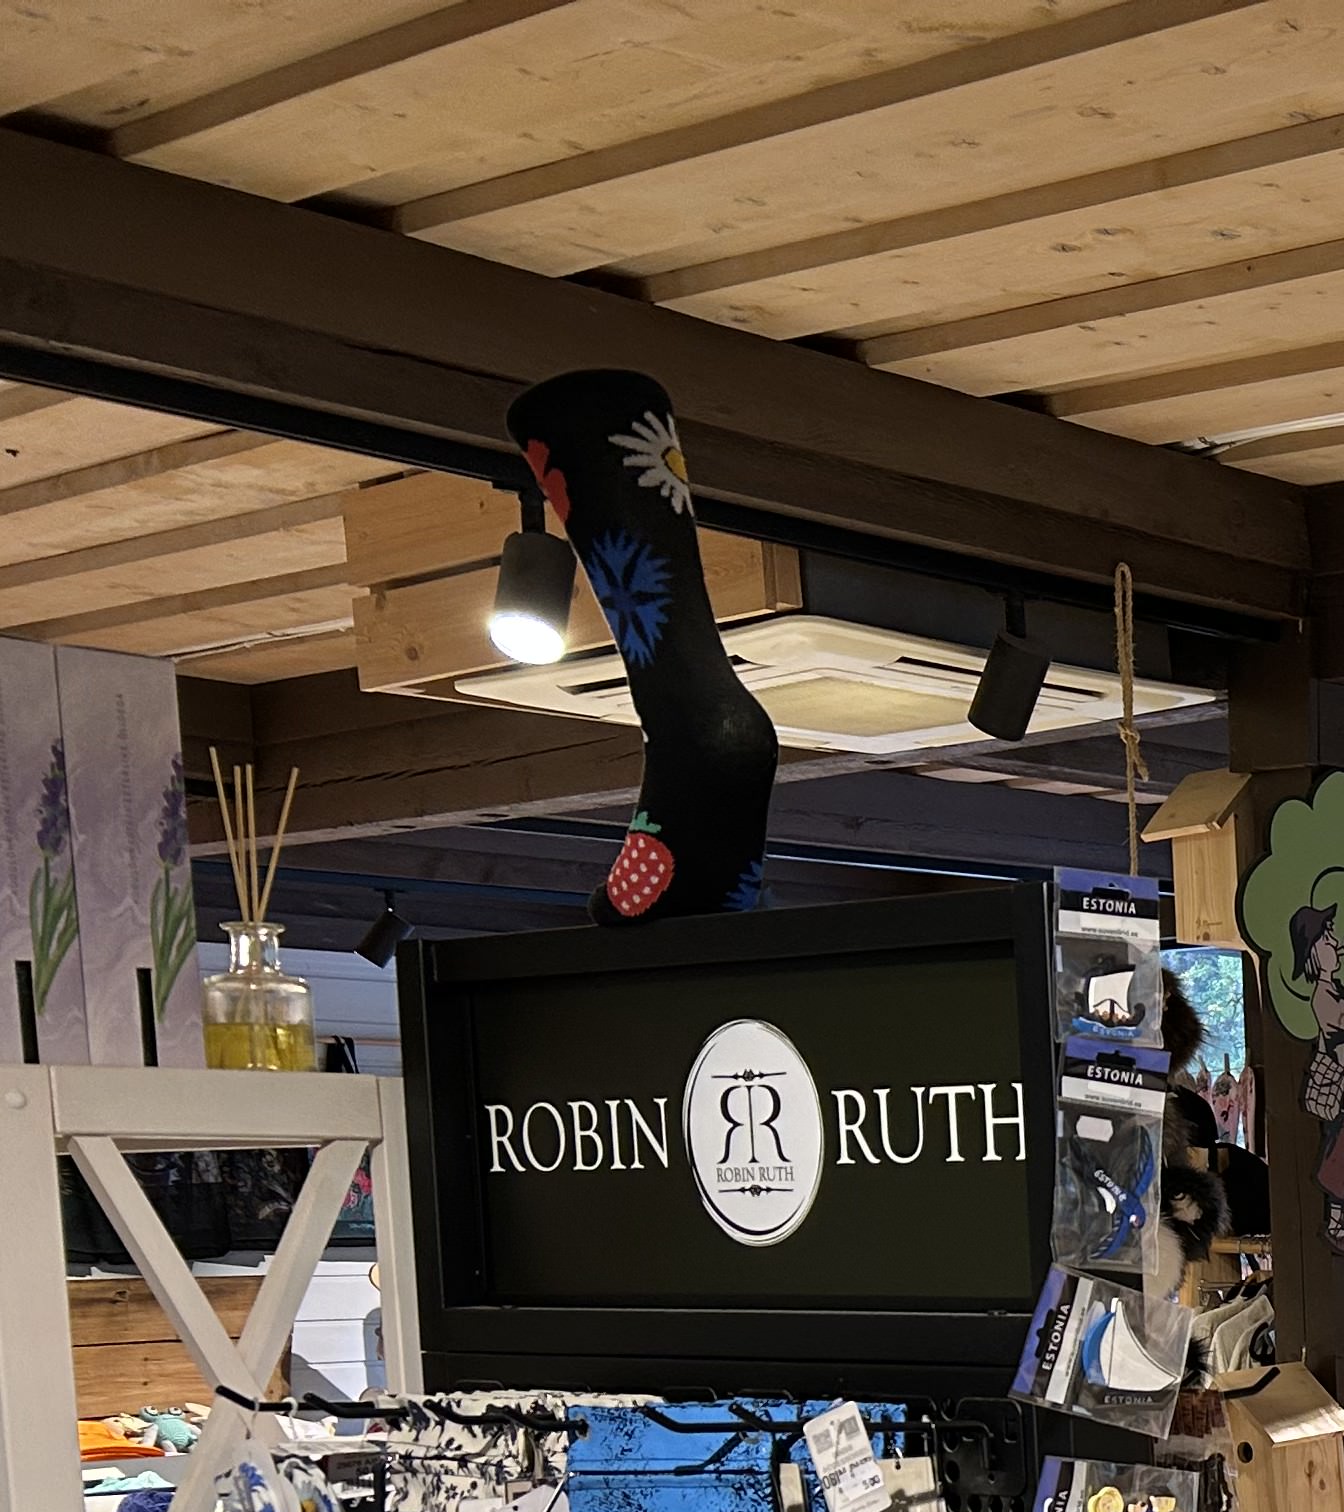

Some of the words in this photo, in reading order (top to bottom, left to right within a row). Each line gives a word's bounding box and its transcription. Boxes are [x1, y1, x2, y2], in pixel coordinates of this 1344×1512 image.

[1082, 896, 1137, 915] ESTONIA
[1086, 1064, 1144, 1086] ESTONIA
[483, 1095, 671, 1176] ROBIN
[834, 1081, 1026, 1166] RUTH
[716, 1166, 755, 1183] ROBIN
[758, 1165, 796, 1183] RUTH
[1041, 1303, 1071, 1371] ESTONIA
[1103, 1394, 1153, 1405] ESTONIA
